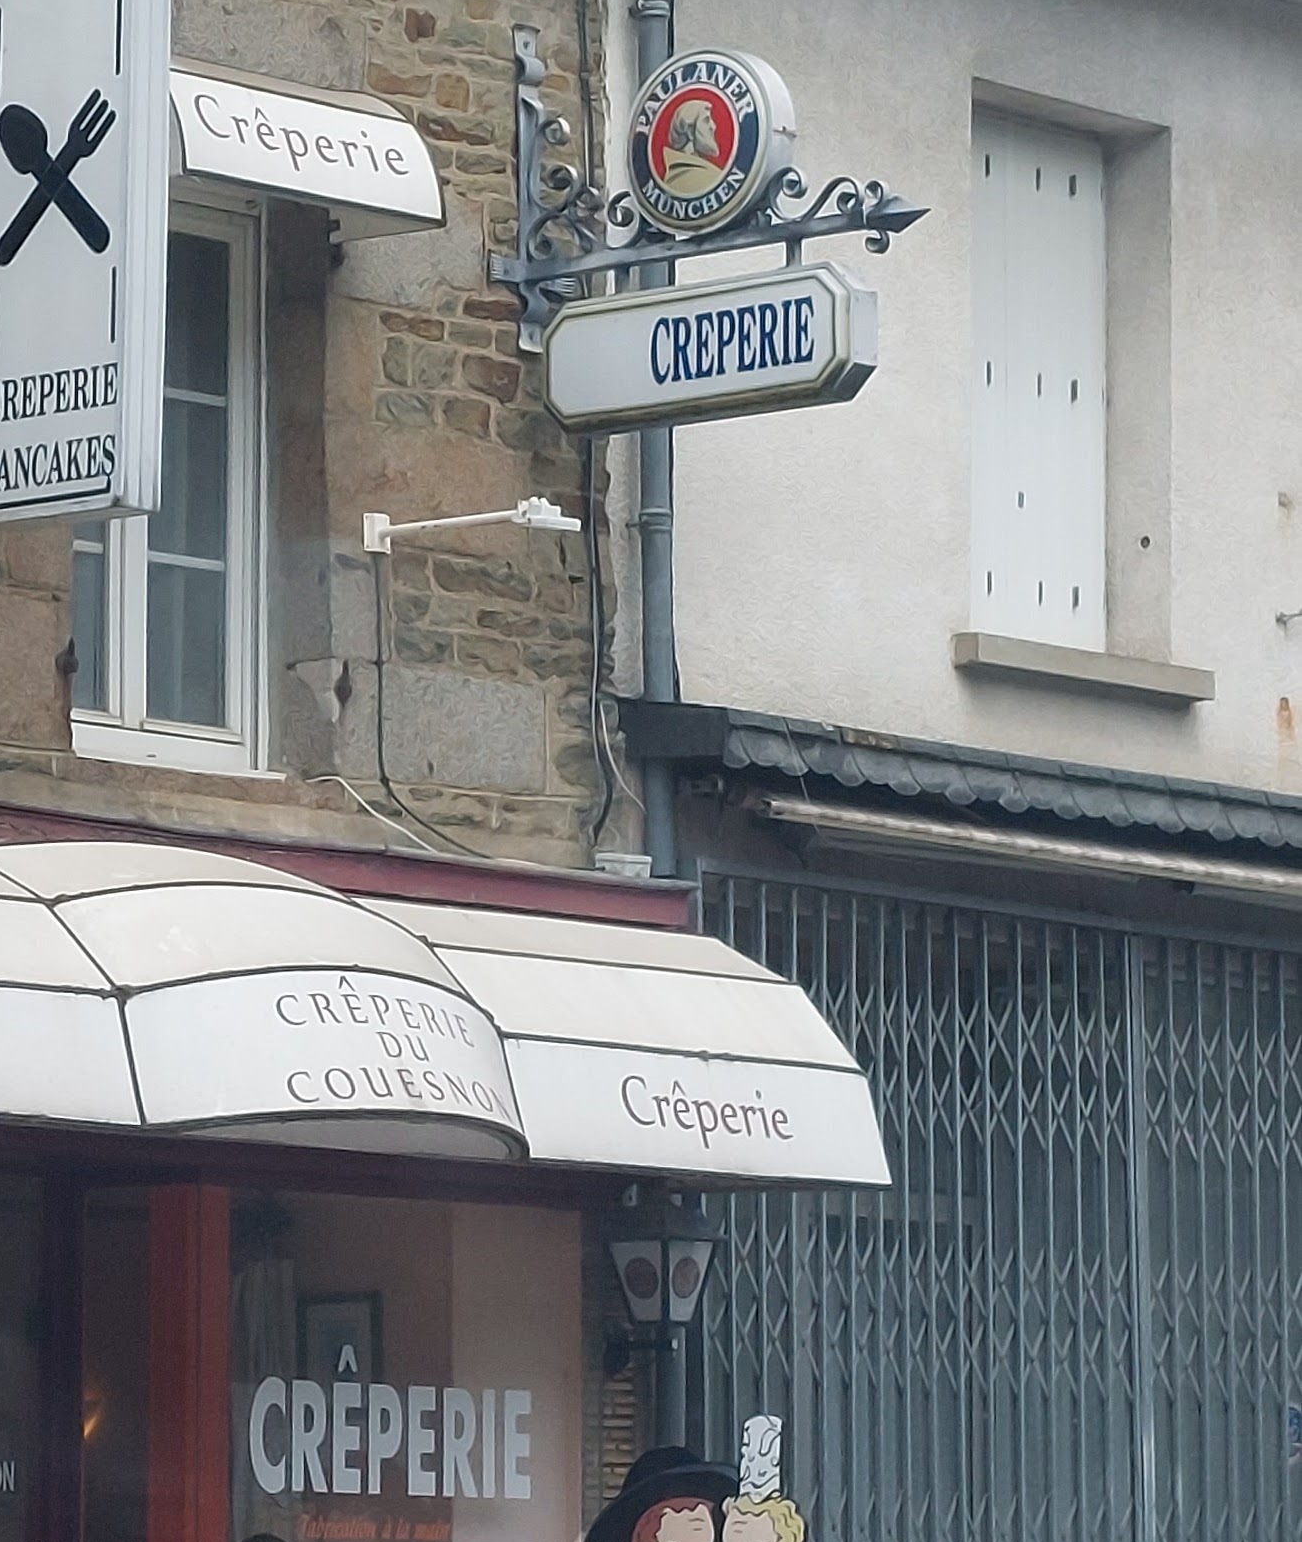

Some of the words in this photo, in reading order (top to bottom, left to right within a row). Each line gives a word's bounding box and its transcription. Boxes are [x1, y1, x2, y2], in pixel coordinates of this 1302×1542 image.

[194, 94, 410, 175] Crêperie
[636, 61, 755, 134] PAULANER
[650, 295, 816, 386] CREPERIE
[276, 974, 475, 1049] CRÊPERIE
[376, 1030, 430, 1062] DU
[287, 1066, 515, 1126] COUESNON
[621, 1075, 794, 1149] Crêperie
[249, 1343, 533, 1500] CRÊPERIE
